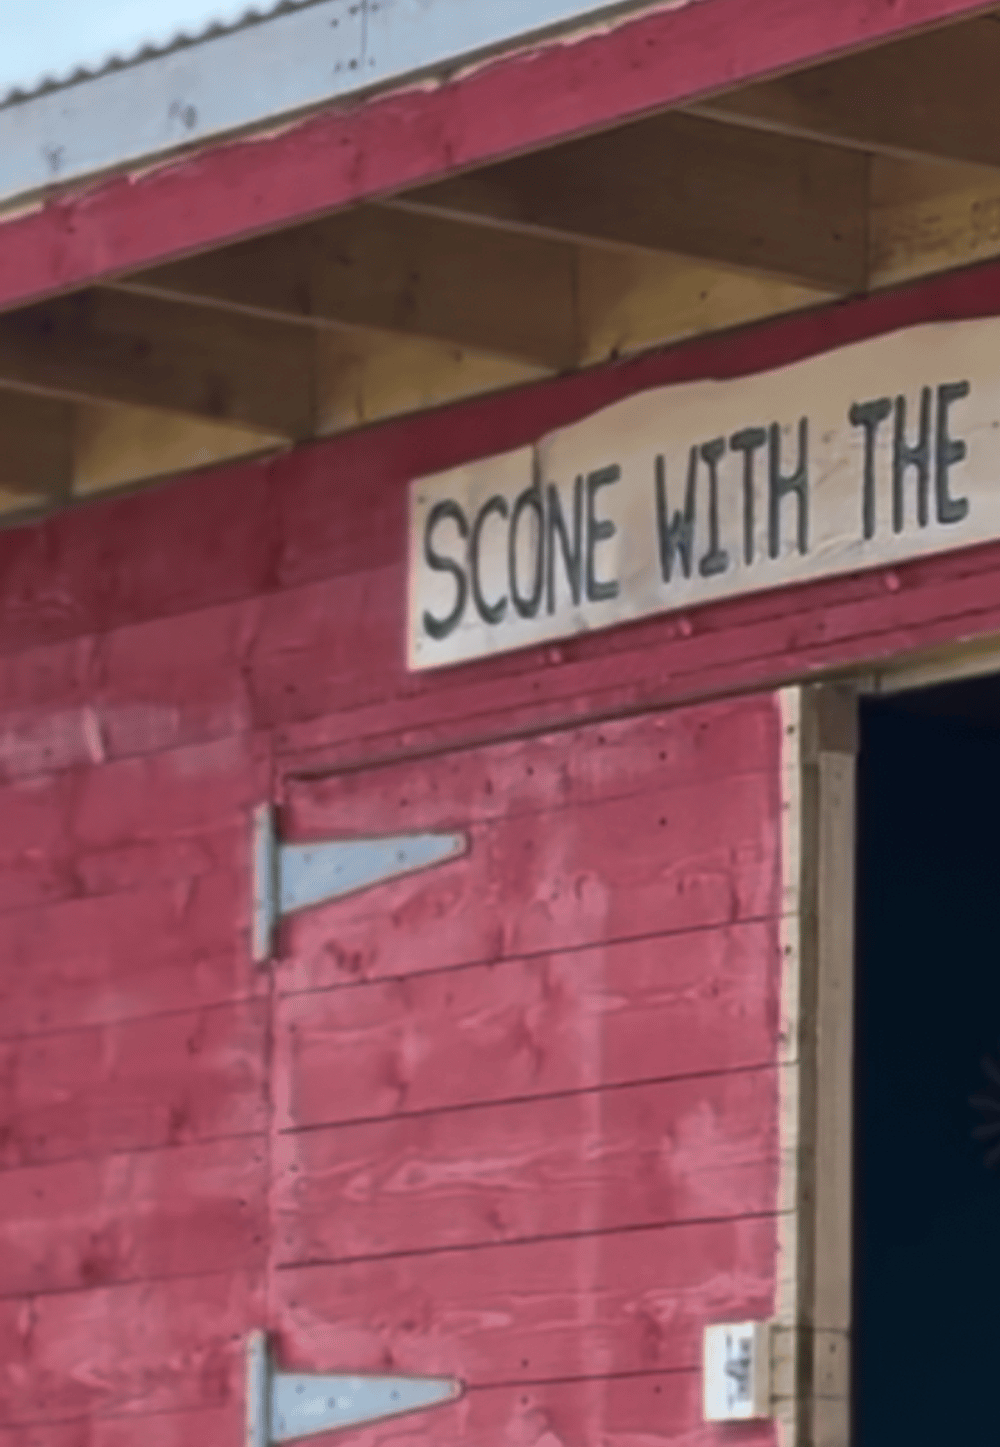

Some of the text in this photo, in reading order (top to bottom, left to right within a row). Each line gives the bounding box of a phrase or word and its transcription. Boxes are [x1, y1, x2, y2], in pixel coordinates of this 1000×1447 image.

[421, 463, 622, 641] SCONE
[655, 415, 809, 584] WITH
[849, 379, 970, 540] THE
